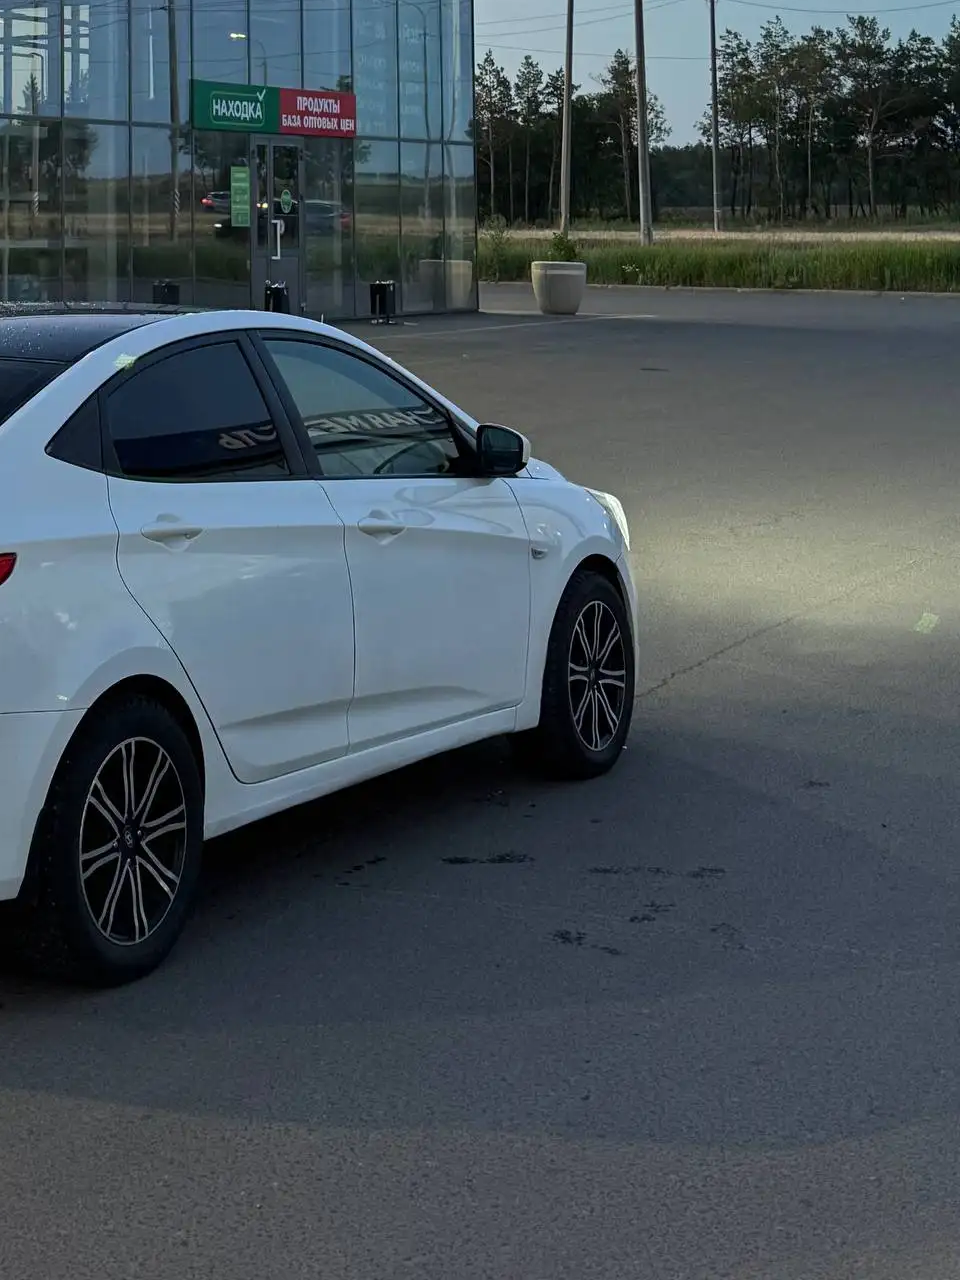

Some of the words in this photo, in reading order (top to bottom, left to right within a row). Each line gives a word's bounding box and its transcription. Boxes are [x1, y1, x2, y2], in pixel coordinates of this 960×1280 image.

[212, 99, 263, 121] НАХОДКА
[296, 96, 340, 113] ПРОДУКТЫ
[282, 114, 301, 128] БАЗА
[303, 116, 338, 130] ОПТОВЫХ
[340, 118, 355, 132] ЦЕН
